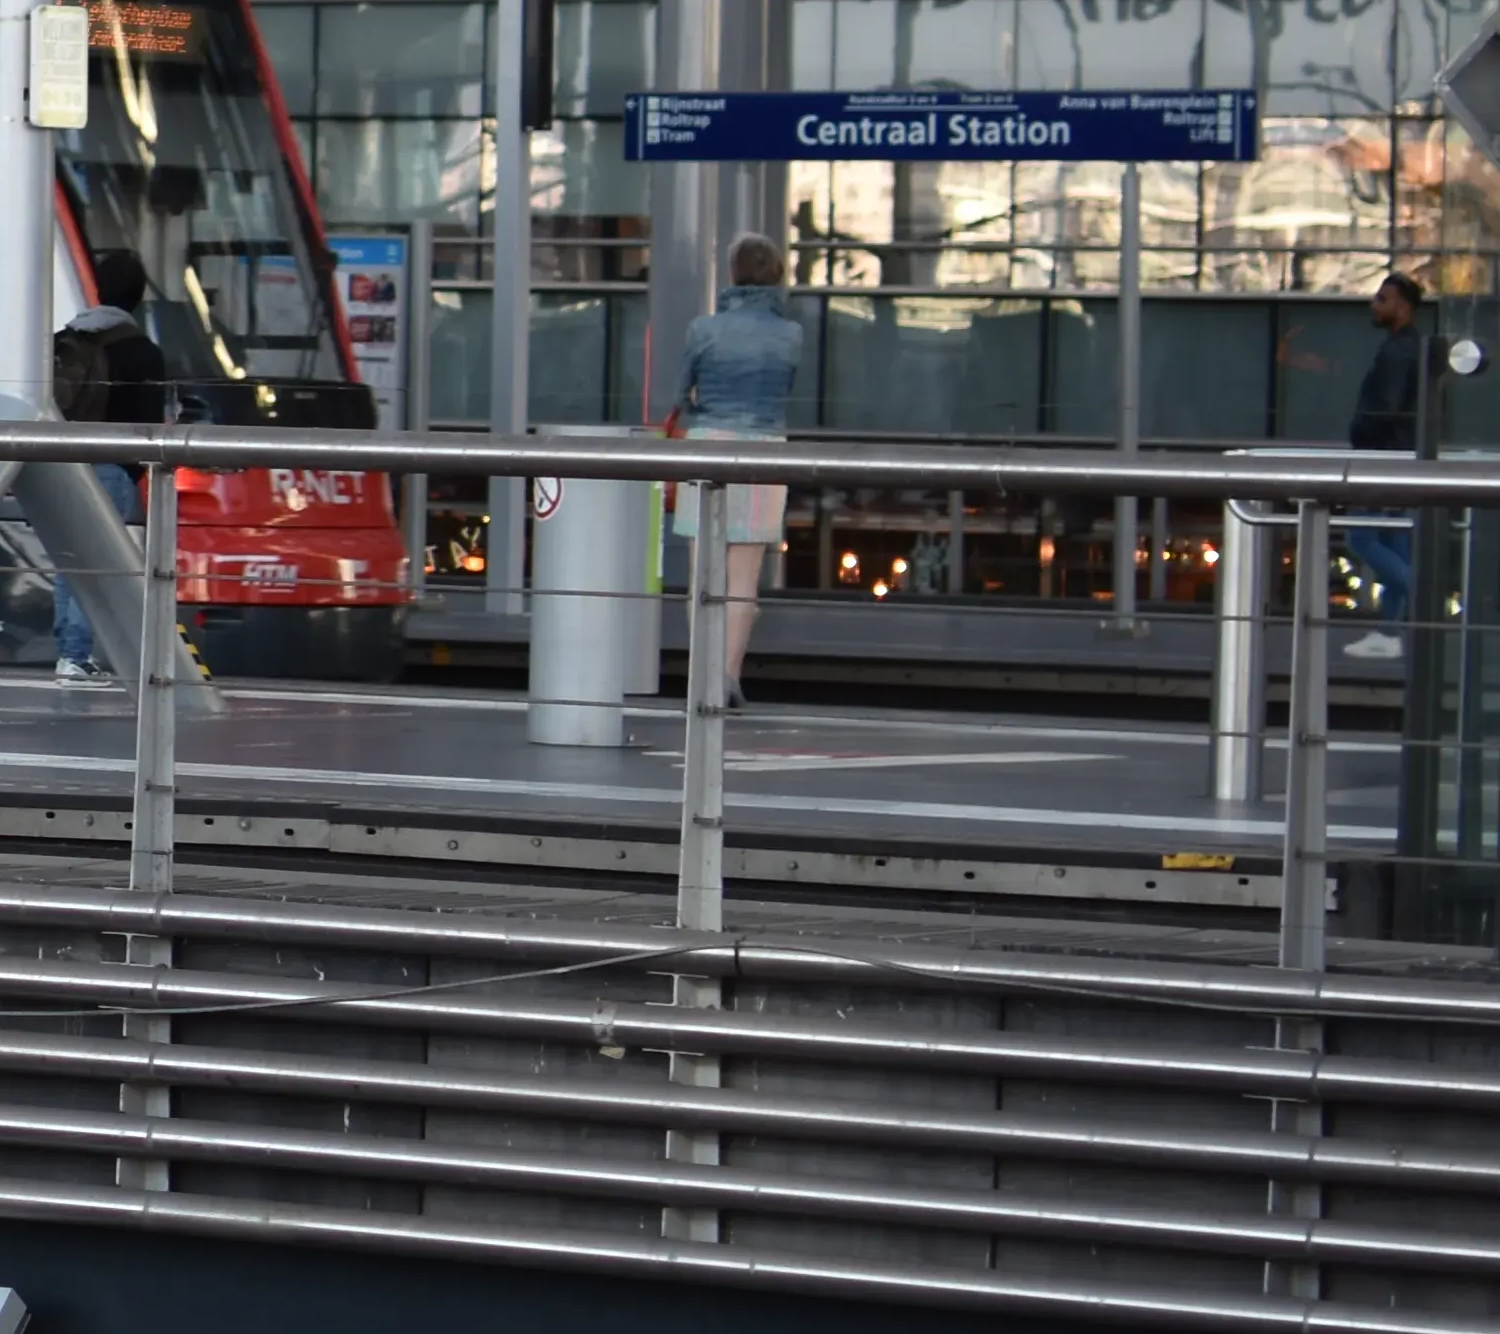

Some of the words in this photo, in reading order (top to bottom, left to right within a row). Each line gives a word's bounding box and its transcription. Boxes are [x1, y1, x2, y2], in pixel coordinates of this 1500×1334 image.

[661, 97, 726, 112] Rijnstraat
[1059, 95, 1097, 109] Anna
[1100, 98, 1127, 109] van
[1130, 94, 1216, 111] Buerenplein
[661, 113, 711, 129] Roltrap
[1163, 112, 1216, 127] Roltrap
[660, 130, 696, 143] Tram
[796, 112, 937, 147] Centraal
[947, 112, 1072, 147] Station
[1190, 128, 1216, 143] Lift
